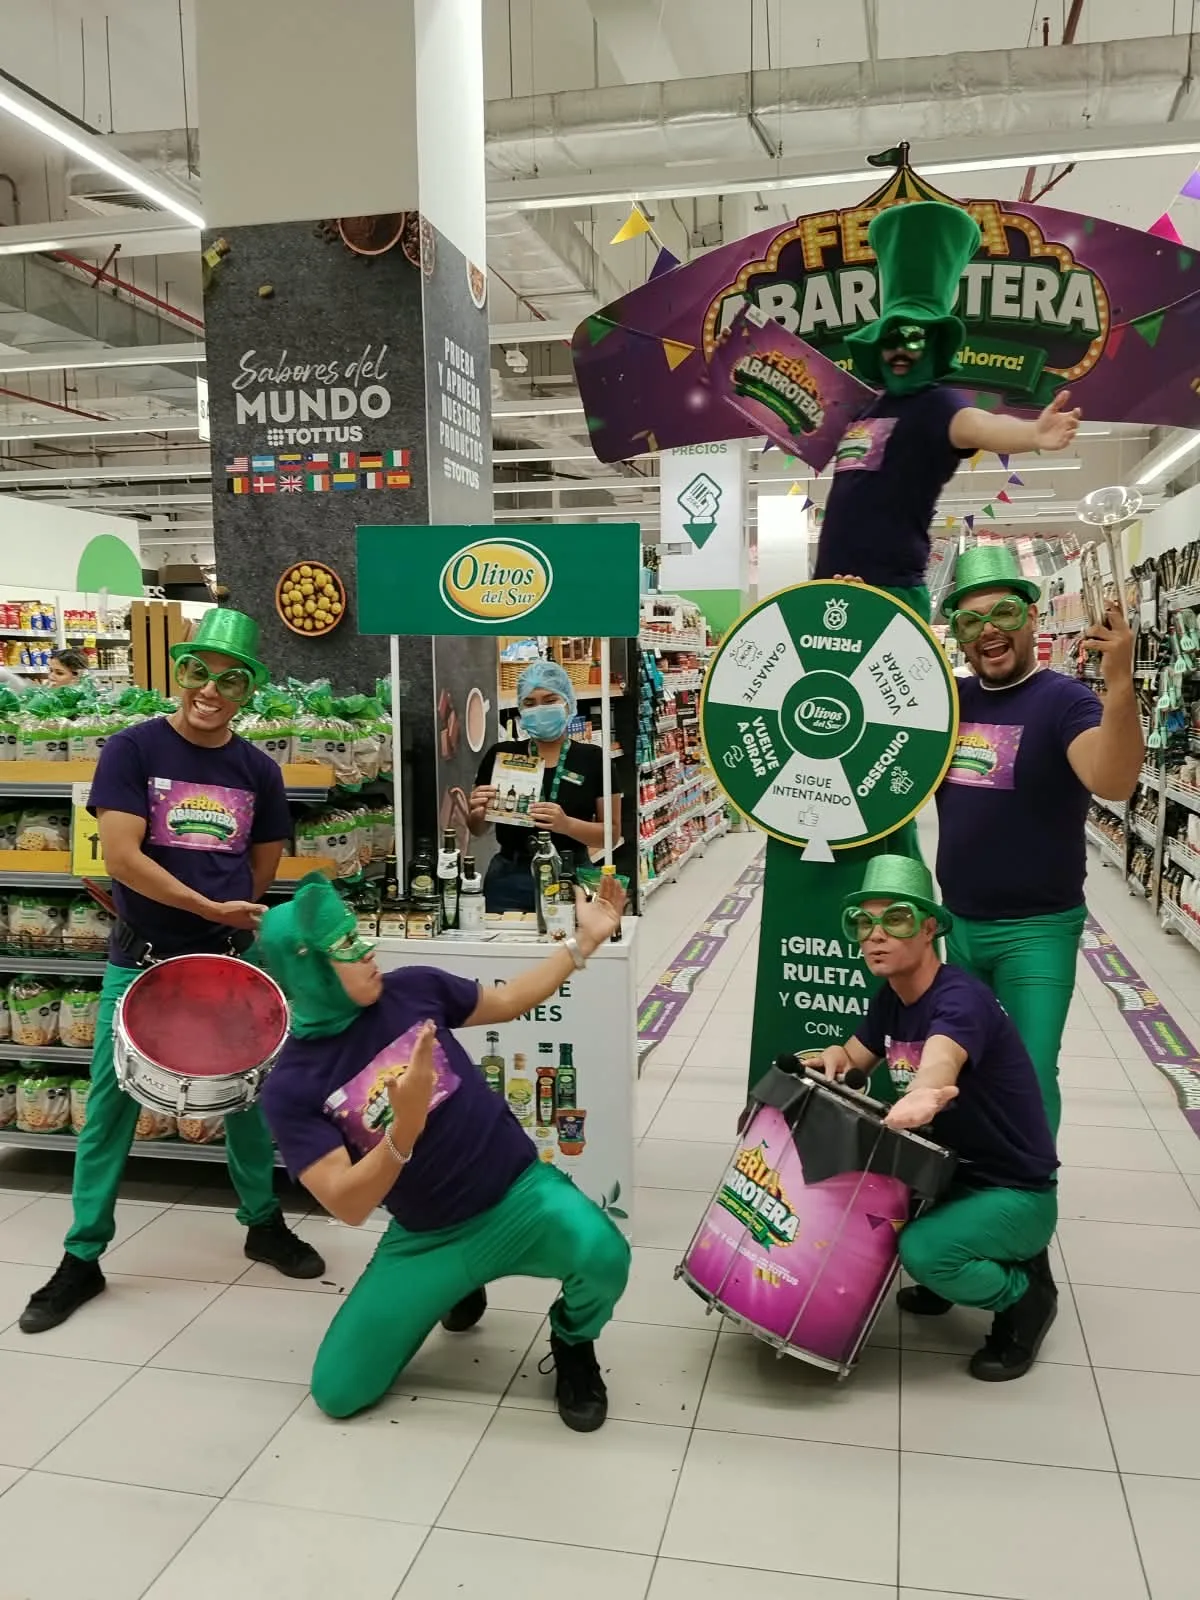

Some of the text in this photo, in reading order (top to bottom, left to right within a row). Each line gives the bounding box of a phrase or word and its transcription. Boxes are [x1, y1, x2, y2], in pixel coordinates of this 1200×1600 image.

[799, 200, 1010, 273] FEA
[231, 343, 389, 391] Sabores del
[444, 336, 475, 380] PRUEBA
[767, 350, 819, 395] FERIA
[235, 384, 392, 425] MUNDO
[438, 360, 481, 411] Y APRUEBA
[737, 355, 825, 428] ABARROTERA
[284, 425, 364, 445] TOTTUS
[441, 392, 481, 437] NUESTROS
[439, 420, 484, 465] PRODUCTOS
[672, 443, 728, 457] PRECIOS
[450, 458, 480, 490] TOTTUS
[452, 553, 535, 591] Olivos
[481, 587, 535, 606] del Sur
[799, 634, 863, 653] PREMIO
[742, 642, 787, 703] GANASTE
[868, 661, 902, 716] VUELVE
[882, 652, 919, 708] A GIRAR
[799, 700, 844, 721] Olivos
[812, 719, 845, 730] del Sur
[736, 722, 767, 778] A GIRAR
[751, 715, 780, 770] VUELVE
[794, 773, 832, 789] SIGUE
[856, 730, 910, 798] OBSEQUIO
[772, 784, 852, 806] INTENTANDO
[781, 936, 843, 958] ¡GIRA
[783, 962, 867, 989] RULETA
[779, 991, 870, 1016] Y GANA!
[804, 1021, 844, 1038] CON:
